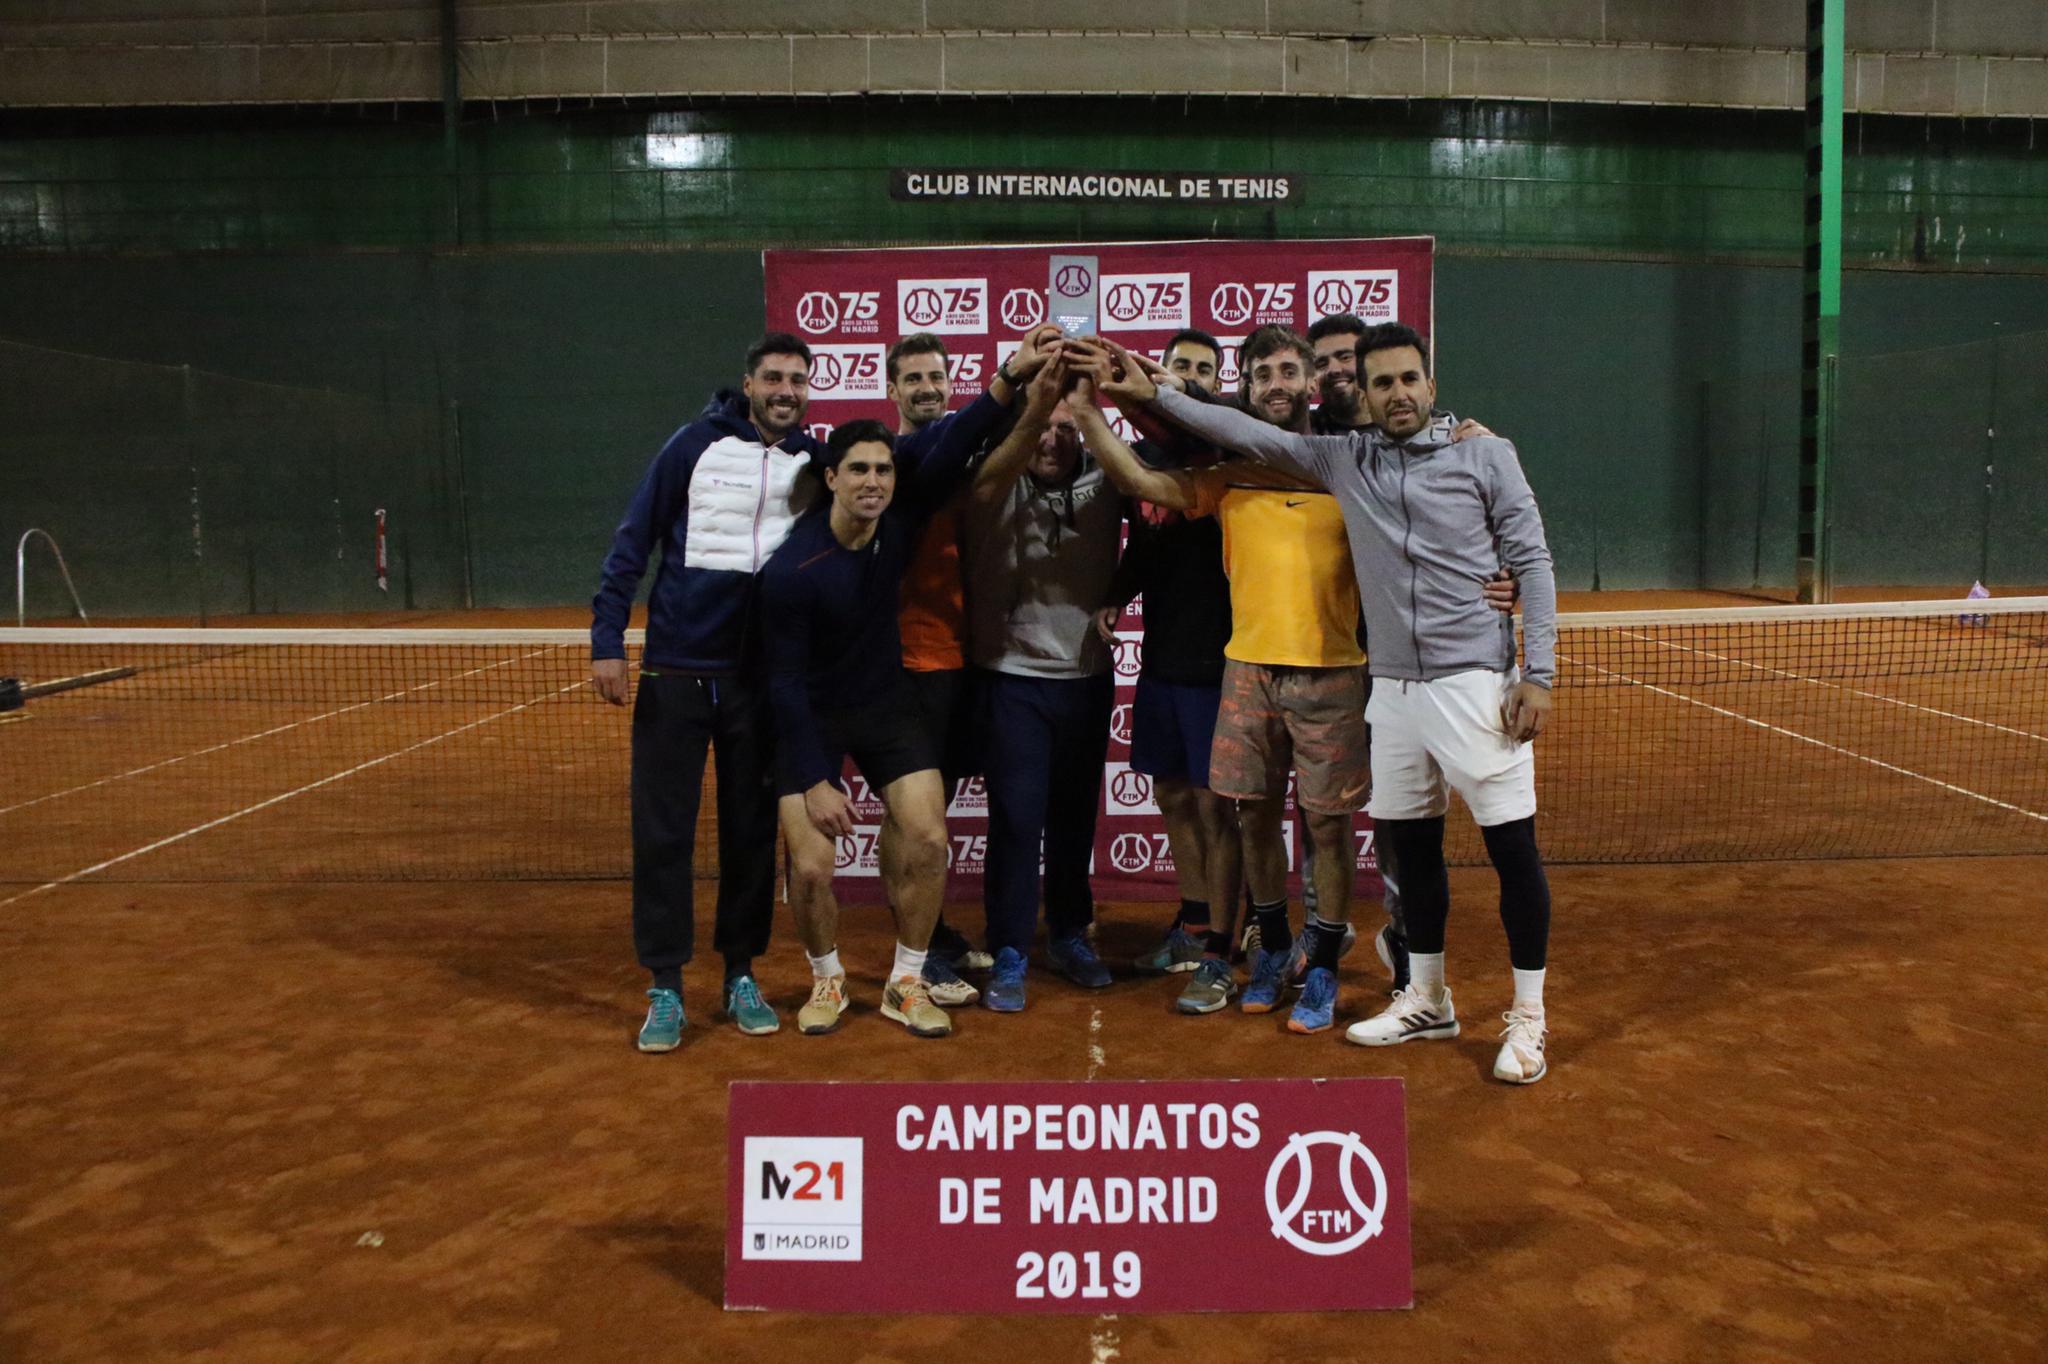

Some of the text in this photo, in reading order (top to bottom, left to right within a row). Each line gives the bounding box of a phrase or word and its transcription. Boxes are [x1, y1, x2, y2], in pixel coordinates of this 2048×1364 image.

[907, 174, 1290, 199] CLUB INTERNACIONAL DE TENIS
[944, 287, 982, 312] 75
[1146, 281, 1185, 308] 75
[1254, 282, 1296, 311] 75
[1354, 278, 1393, 305] 75
[839, 291, 881, 320] 75
[915, 312, 932, 320] FTM
[1117, 307, 1134, 316] FTM
[1223, 309, 1241, 318] FTM
[1325, 303, 1342, 312] FTM
[808, 318, 827, 327] FTM
[852, 325, 879, 333] MADRID
[1013, 314, 1032, 324] FTM
[1267, 317, 1295, 325] MADRID
[843, 353, 880, 378] 75
[947, 354, 984, 381] 75
[1221, 369, 1238, 377] FTM
[1125, 602, 1143, 616] EN
[1121, 662, 1138, 671] FTM
[1120, 729, 1132, 738] FT
[1122, 793, 1139, 801] FTM
[953, 835, 987, 861] 75
[1152, 833, 1172, 859] 7
[1355, 830, 1375, 856] 7
[1122, 858, 1140, 866] FTM
[896, 1102, 1261, 1150] CAMPEONATOS
[761, 1160, 844, 1201] M21
[939, 1176, 1218, 1224] DE MADRID
[1302, 1209, 1352, 1234] FTM
[776, 1234, 850, 1250] MADRID
[1015, 1250, 1141, 1299] 2019
